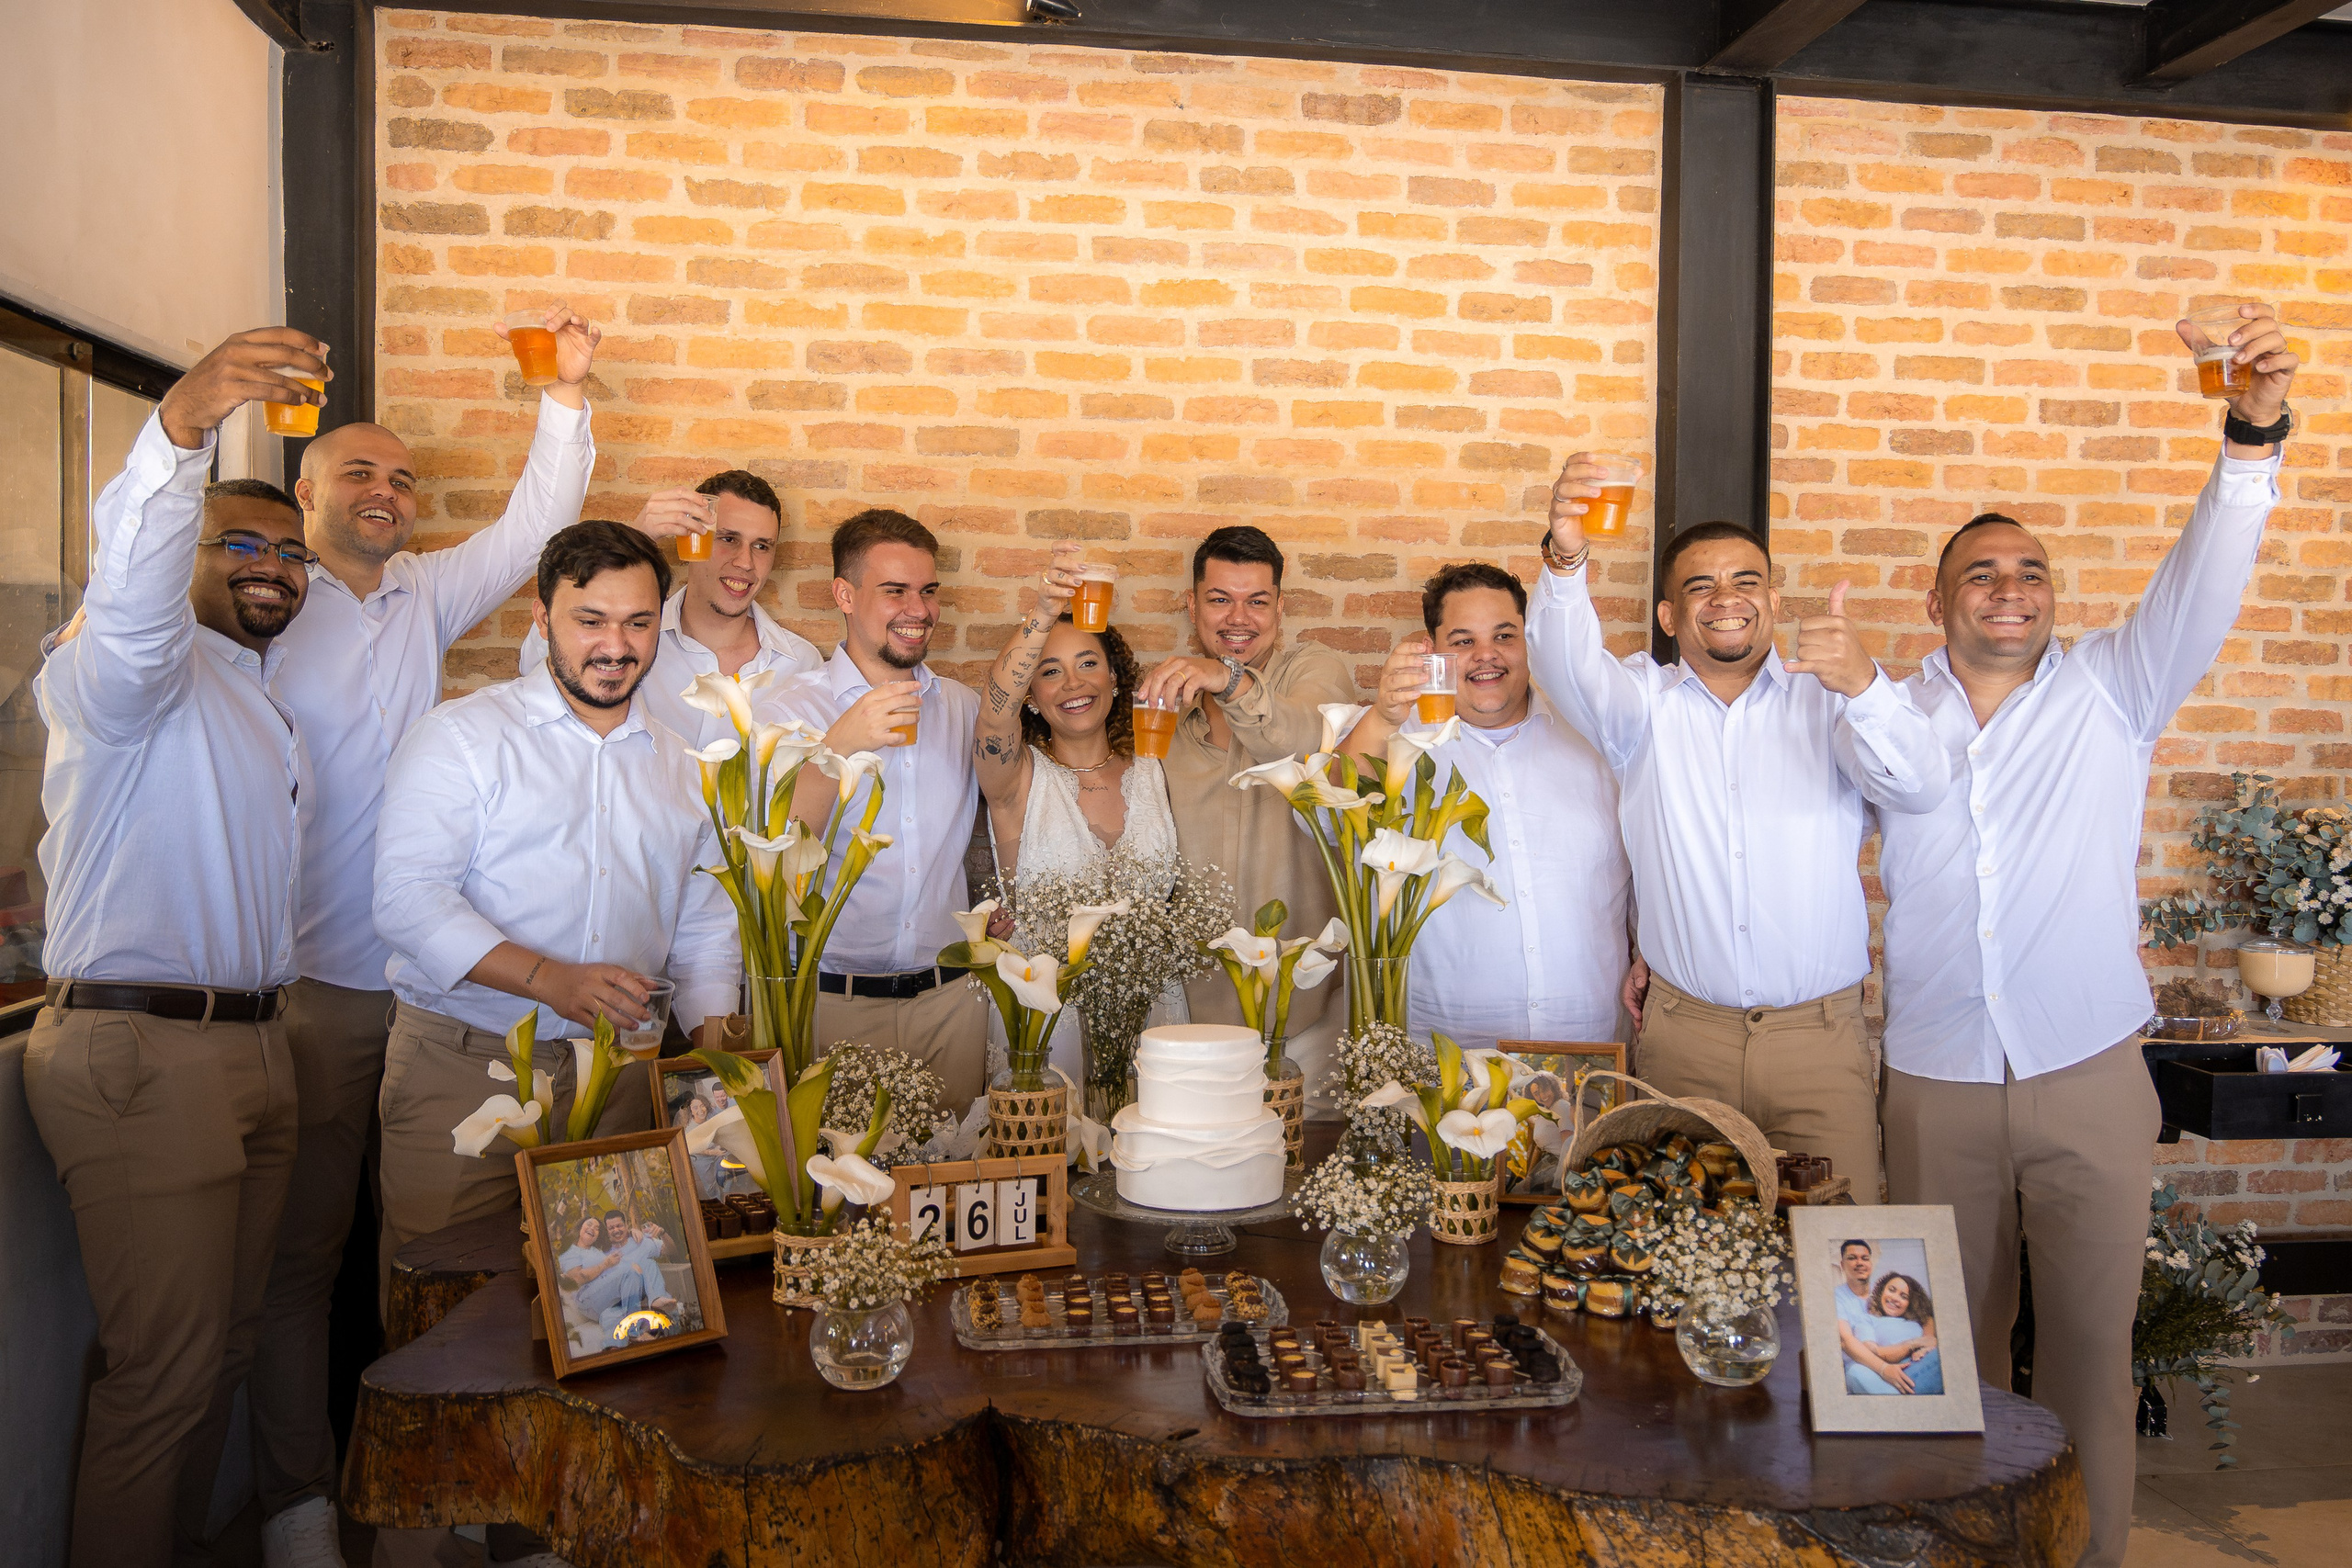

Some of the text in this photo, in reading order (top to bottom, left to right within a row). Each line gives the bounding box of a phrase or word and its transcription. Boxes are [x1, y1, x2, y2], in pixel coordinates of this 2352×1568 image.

[918, 1192, 1027, 1245] 2 6 JUL
